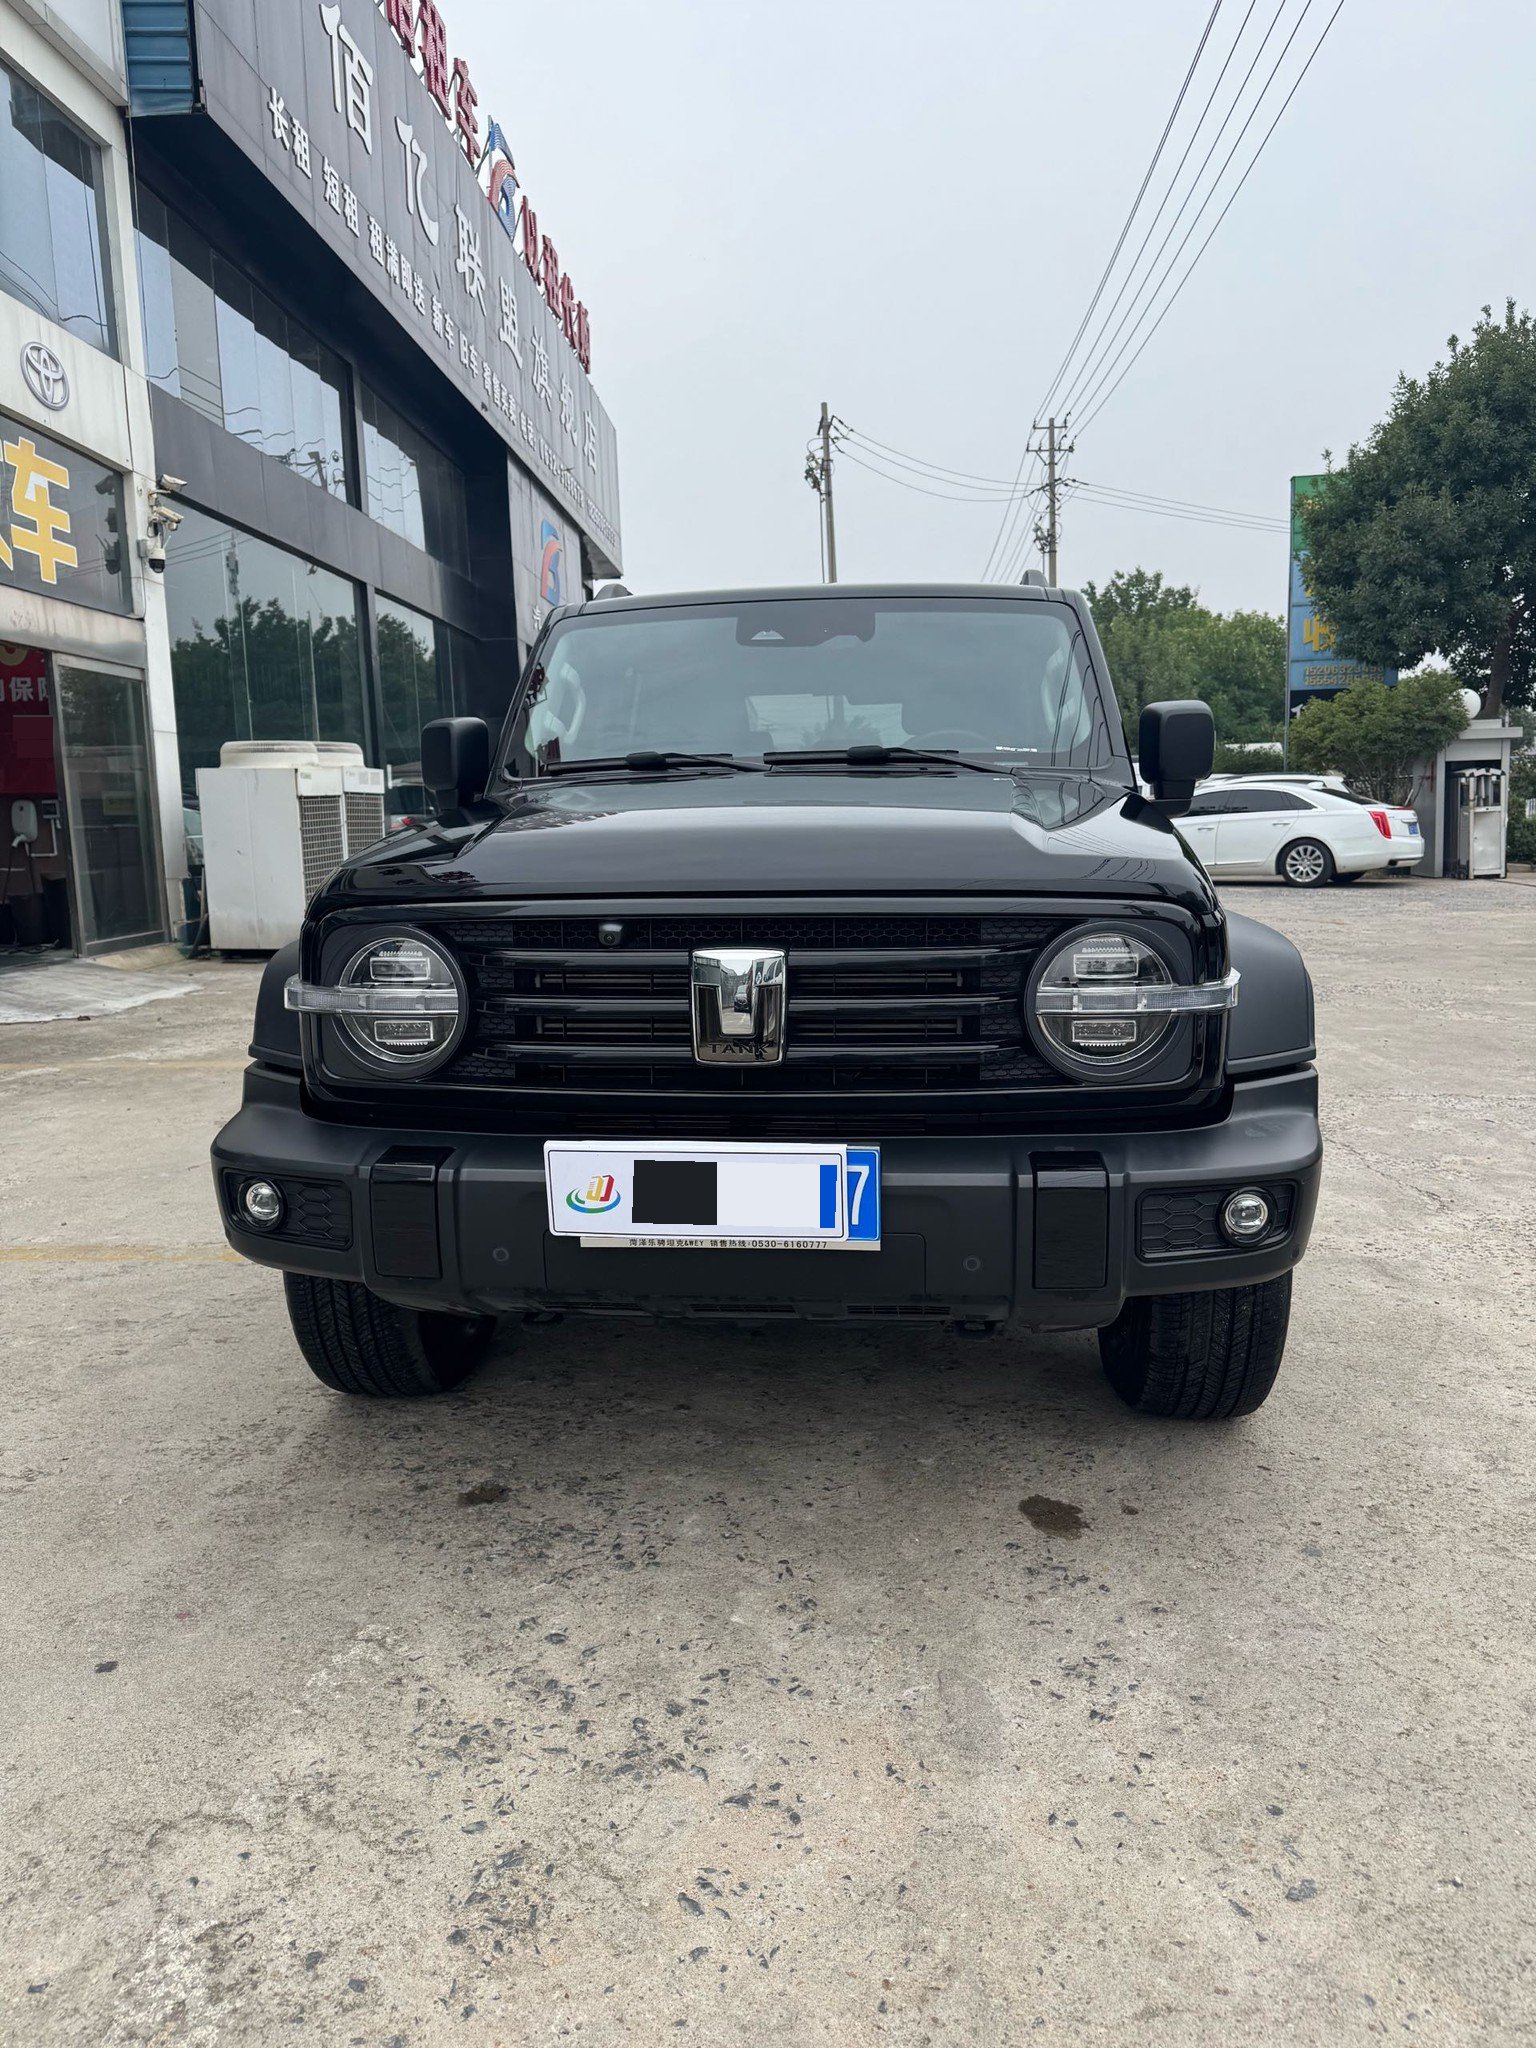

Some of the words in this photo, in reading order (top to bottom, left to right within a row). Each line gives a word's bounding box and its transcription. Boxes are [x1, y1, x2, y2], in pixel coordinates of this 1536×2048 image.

[267, 87, 312, 179] 长租
[323, 156, 360, 238] 短租
[431, 296, 455, 351] 新车
[0, 436, 78, 585] 车
[708, 1042, 769, 1054] TANK
[847, 1165, 869, 1225] 7
